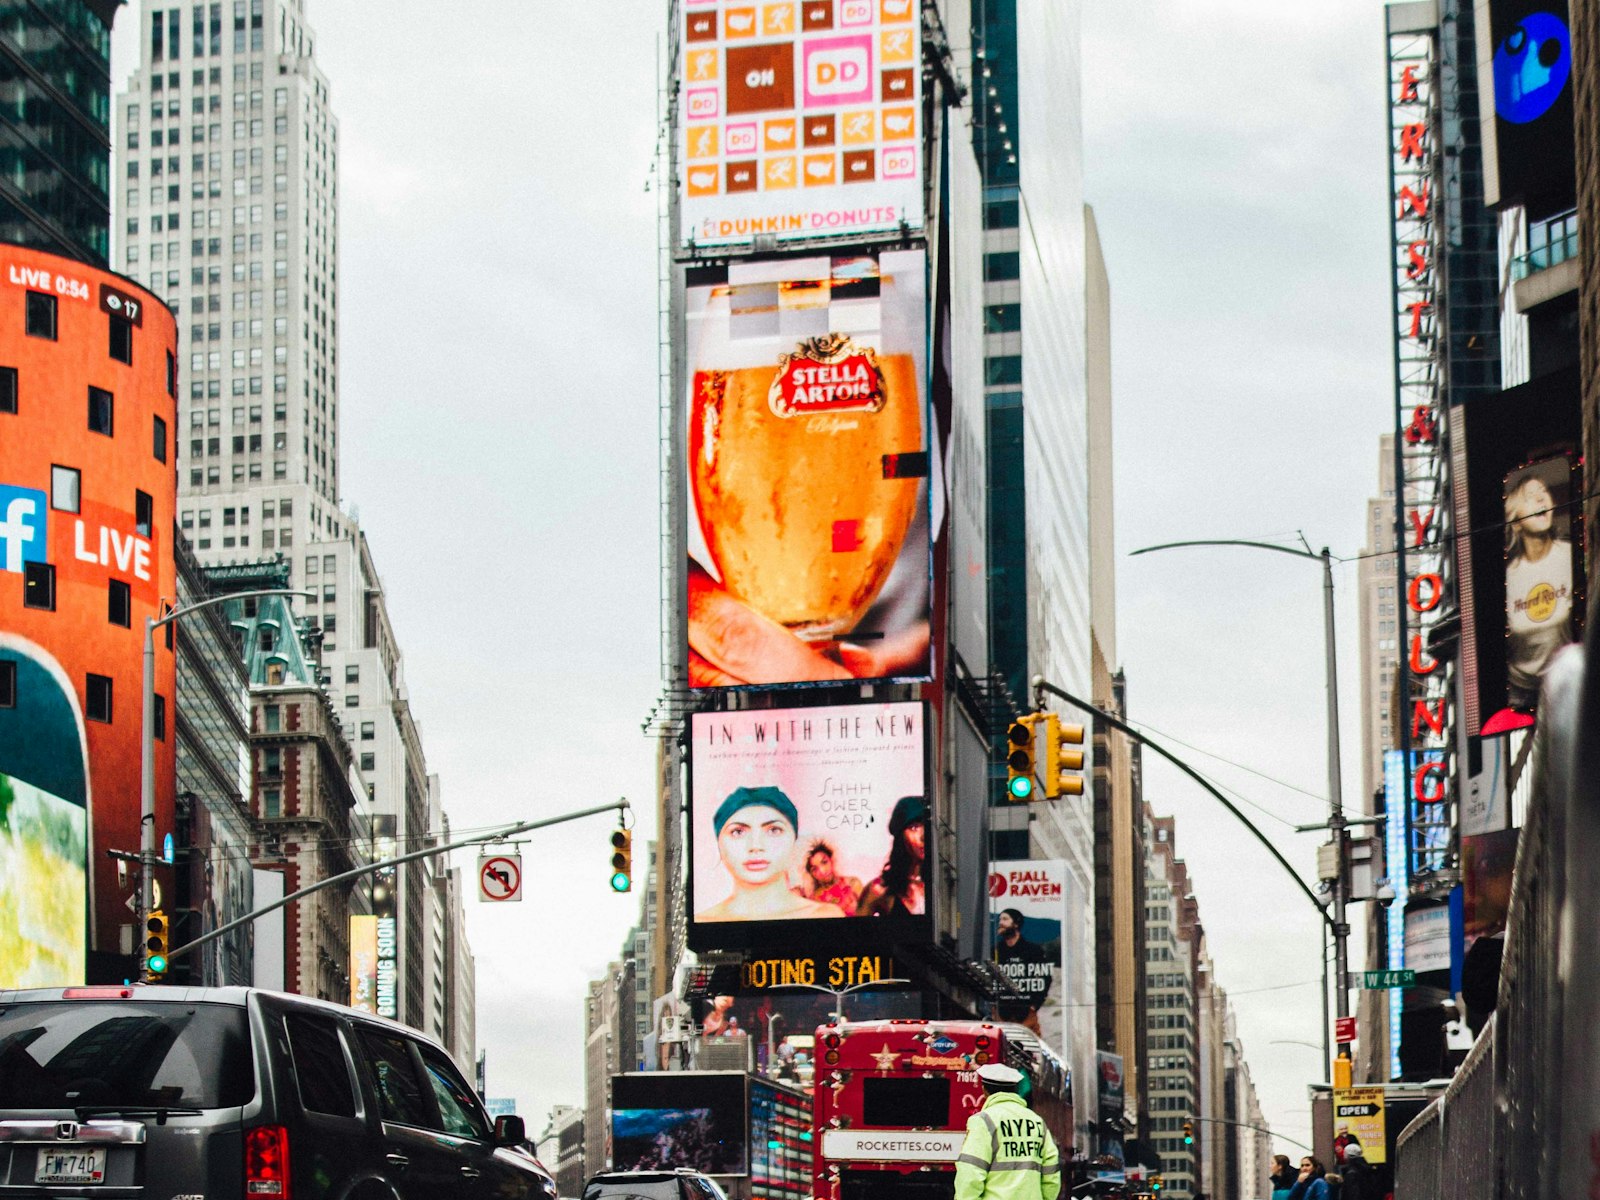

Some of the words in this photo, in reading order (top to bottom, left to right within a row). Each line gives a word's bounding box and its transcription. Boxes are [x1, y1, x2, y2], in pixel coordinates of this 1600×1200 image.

[1399, 65, 1429, 338] ERNST
[811, 207, 895, 228] DONUTS
[9, 264, 50, 290] LIVE
[55, 276, 90, 301] 0:54
[124, 300, 138, 319] 17
[792, 364, 869, 386] STELLA
[791, 382, 870, 404] ARTOIS
[1405, 405, 1436, 443] &
[0, 497, 36, 573] f
[75, 519, 151, 582] LIVE
[709, 724, 733, 746] IN
[754, 719, 812, 743] WITH
[826, 716, 861, 739] THE
[874, 714, 915, 737] NEW
[821, 799, 871, 813] OWER
[377, 918, 396, 957] SOON
[1028, 962, 1055, 978] PANT
[1367, 975, 1378, 987] W
[1383, 974, 1399, 985] 44
[377, 960, 396, 1017] COMING
[1340, 1106, 1369, 1116] OPEN
[856, 1141, 952, 1153] ROCKETTES.COM
[45, 1155, 95, 1174] FW-740
